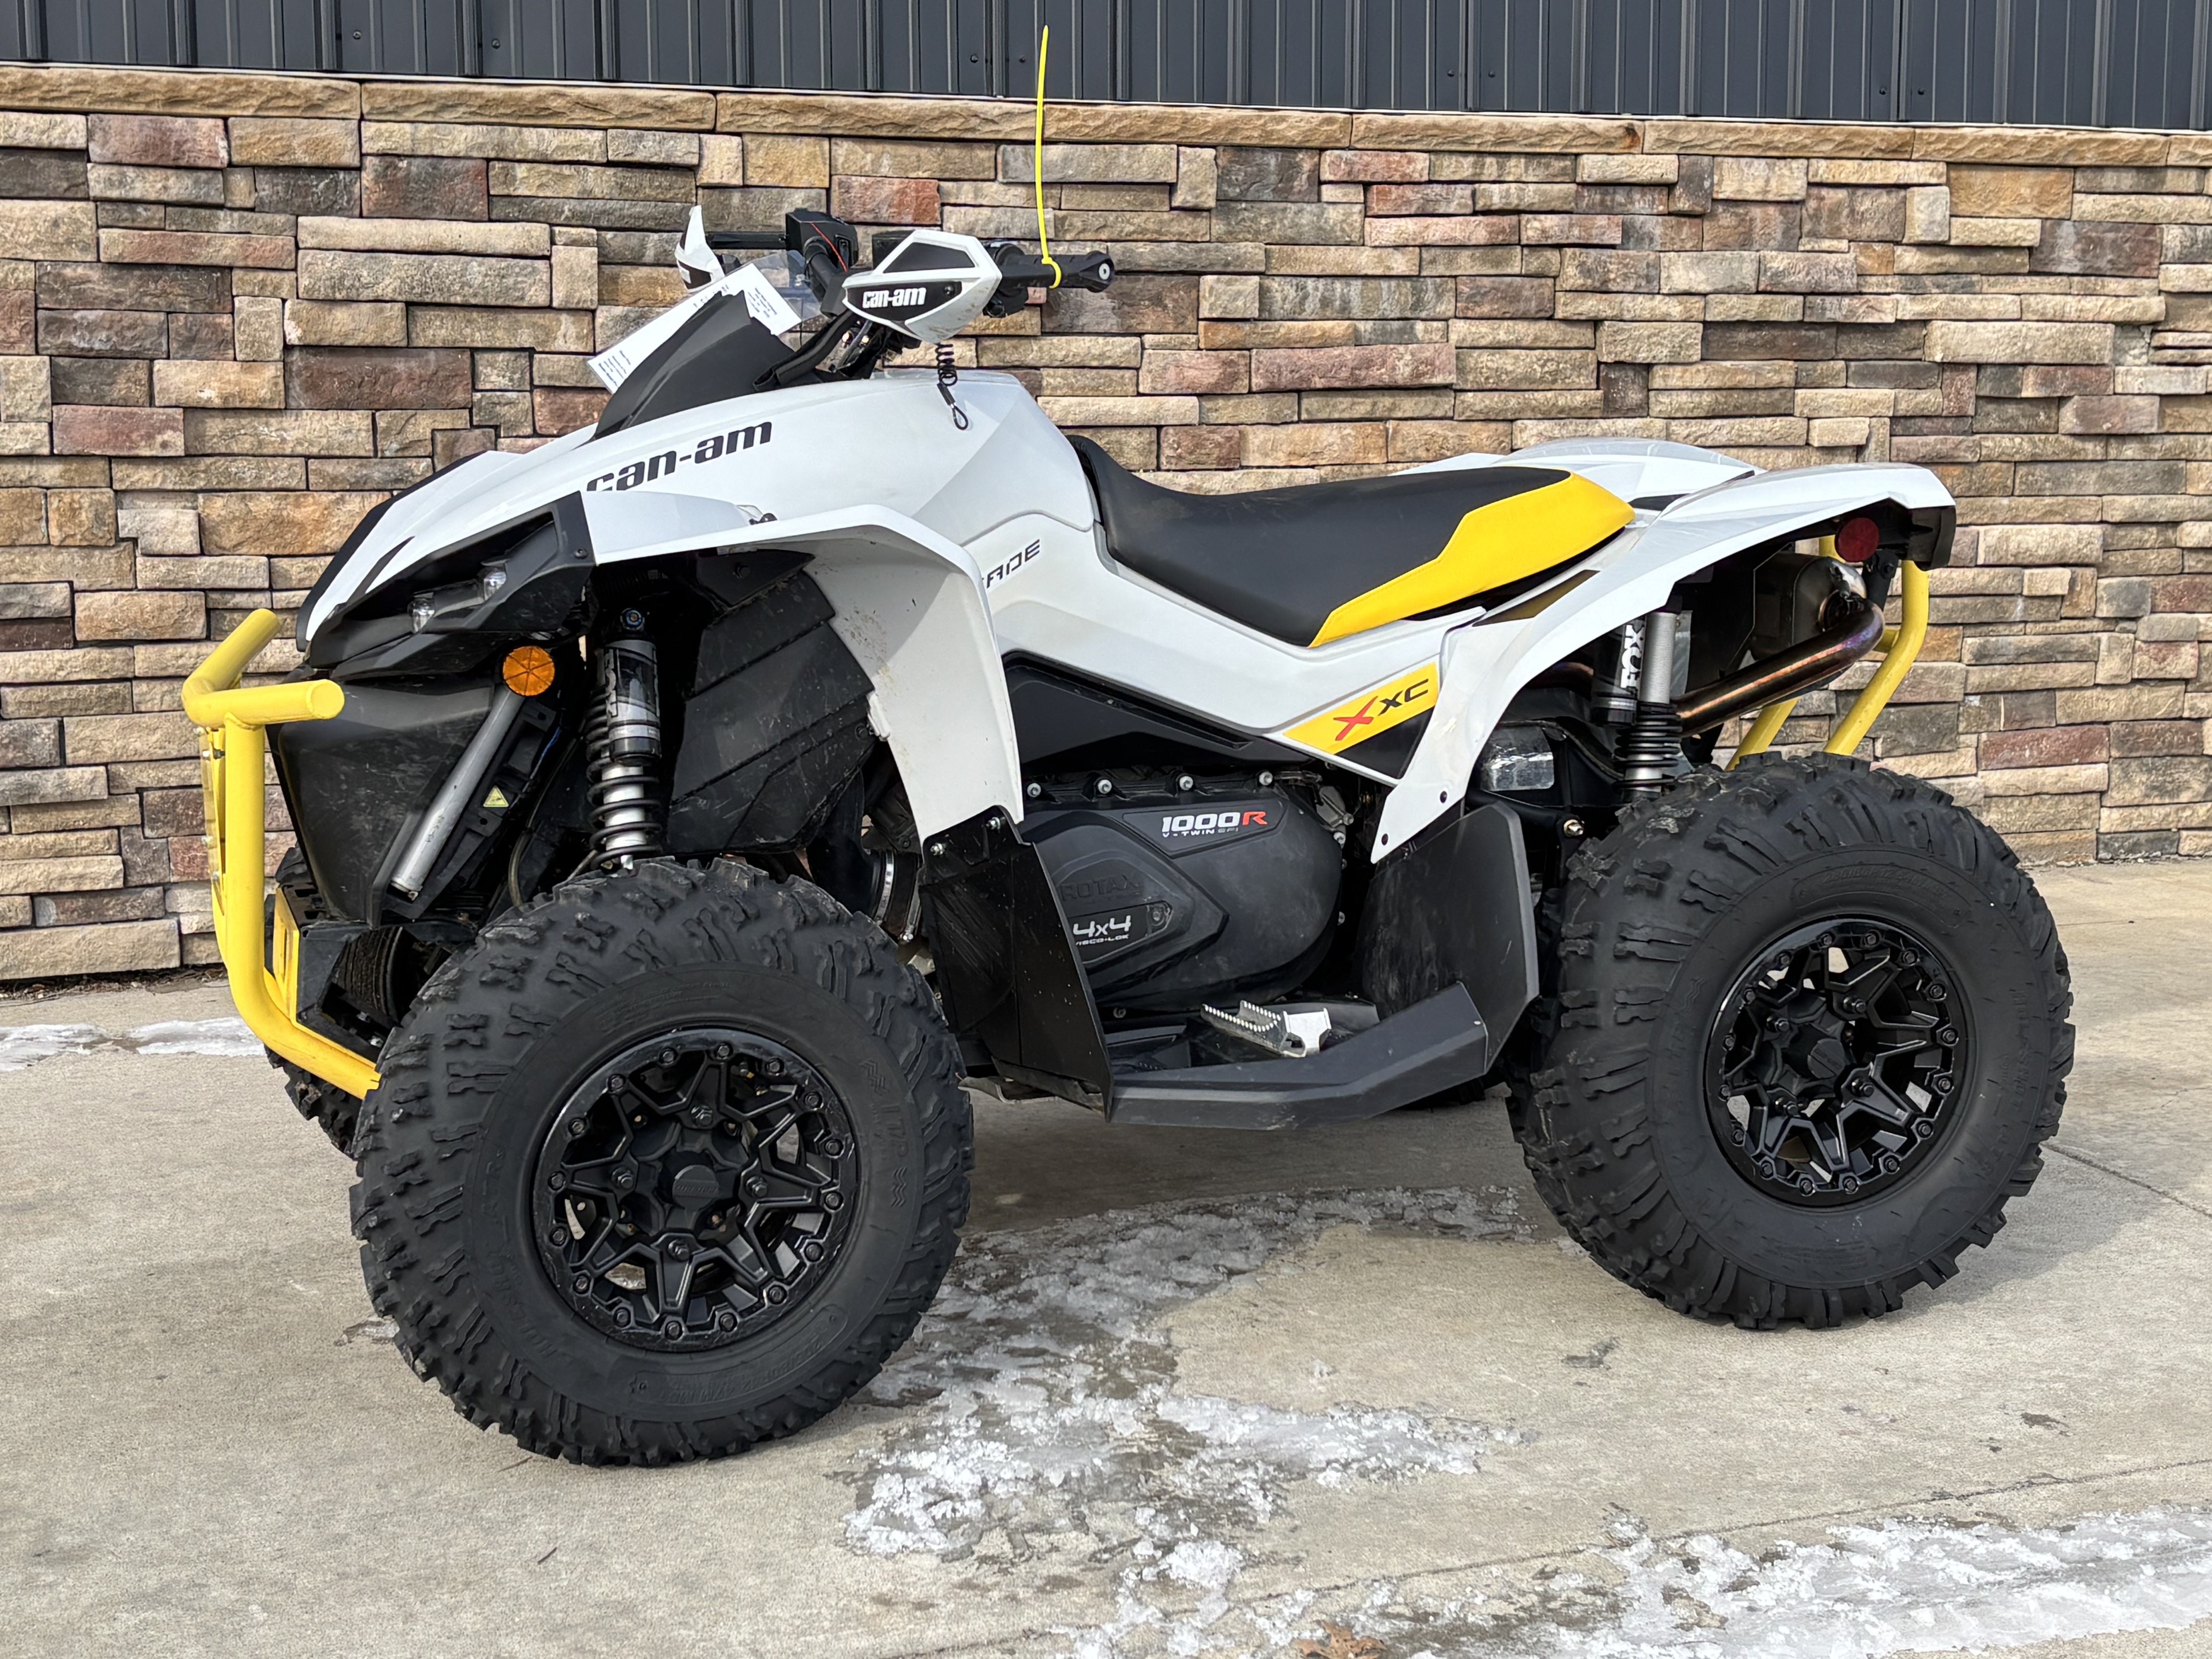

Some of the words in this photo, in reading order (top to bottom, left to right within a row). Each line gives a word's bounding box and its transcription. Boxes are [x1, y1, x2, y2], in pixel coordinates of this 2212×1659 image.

[862, 287, 927, 309] can-am
[586, 422, 772, 491] can-am
[982, 539, 1040, 589] ADE
[1620, 624, 1645, 689] FOX
[1162, 811, 1268, 833] 1000R
